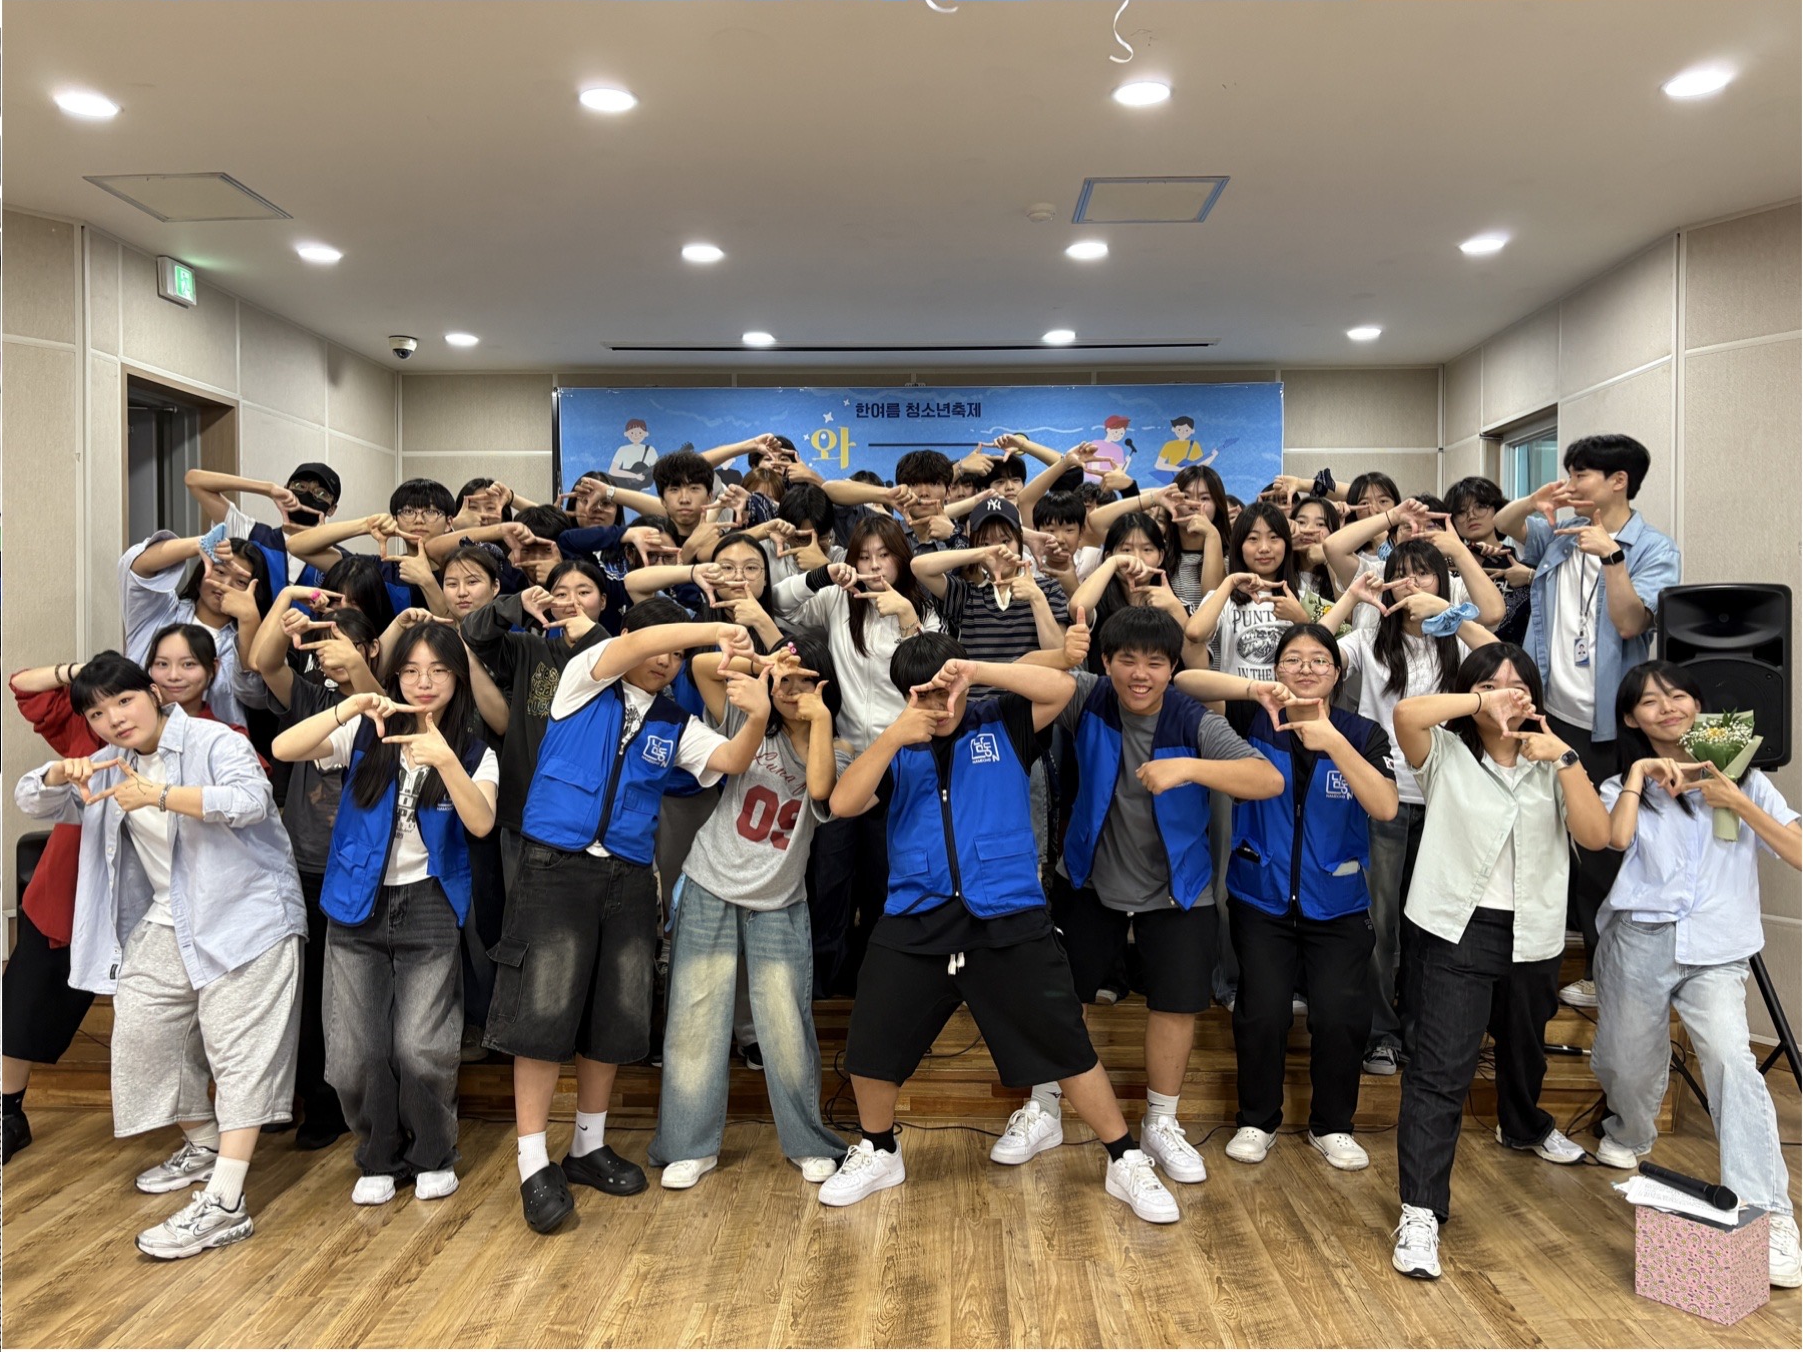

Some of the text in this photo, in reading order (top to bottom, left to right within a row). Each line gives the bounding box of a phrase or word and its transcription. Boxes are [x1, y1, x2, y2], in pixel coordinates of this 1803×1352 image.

[855, 401, 982, 419] 한여름 청소년축제
[811, 426, 857, 470] 와
[1250, 668, 1273, 681] THE
